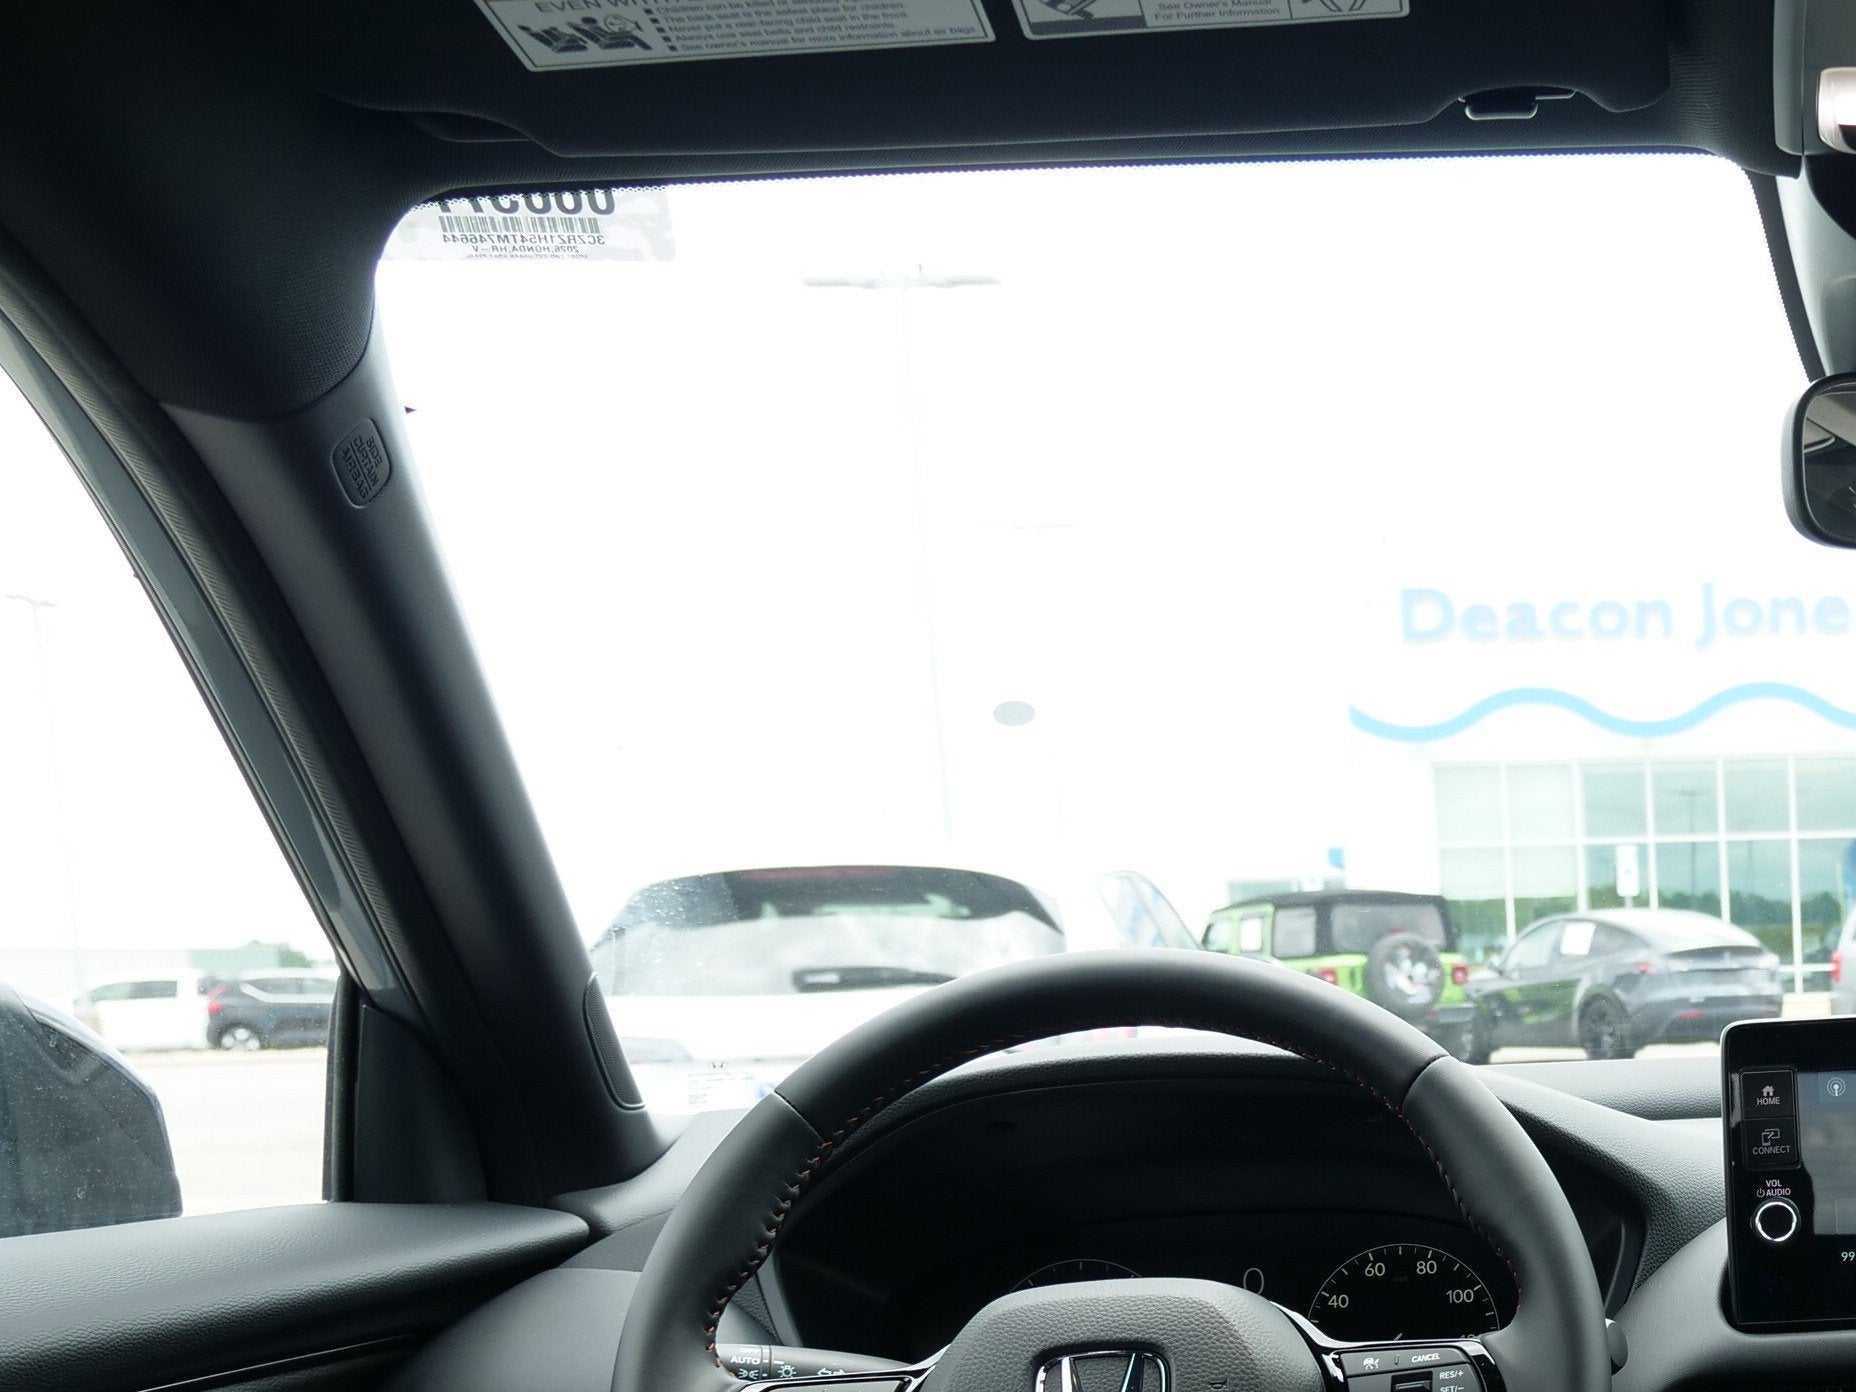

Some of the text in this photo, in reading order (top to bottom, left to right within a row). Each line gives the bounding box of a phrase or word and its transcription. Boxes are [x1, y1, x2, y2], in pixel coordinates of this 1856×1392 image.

[1401, 588, 1672, 646] Deacon
[1756, 1095, 1781, 1106] HOME
[1752, 1144, 1791, 1156] CONNECT
[1765, 1179, 1782, 1188] VOL
[1766, 1187, 1791, 1197] AUDIO
[1364, 1263, 1385, 1277] 60
[1416, 1260, 1437, 1275] 80
[1327, 1294, 1349, 1309] 40
[1446, 1289, 1474, 1303] 100
[730, 1355, 760, 1364] AUTO
[1411, 1352, 1441, 1363] CANCEL
